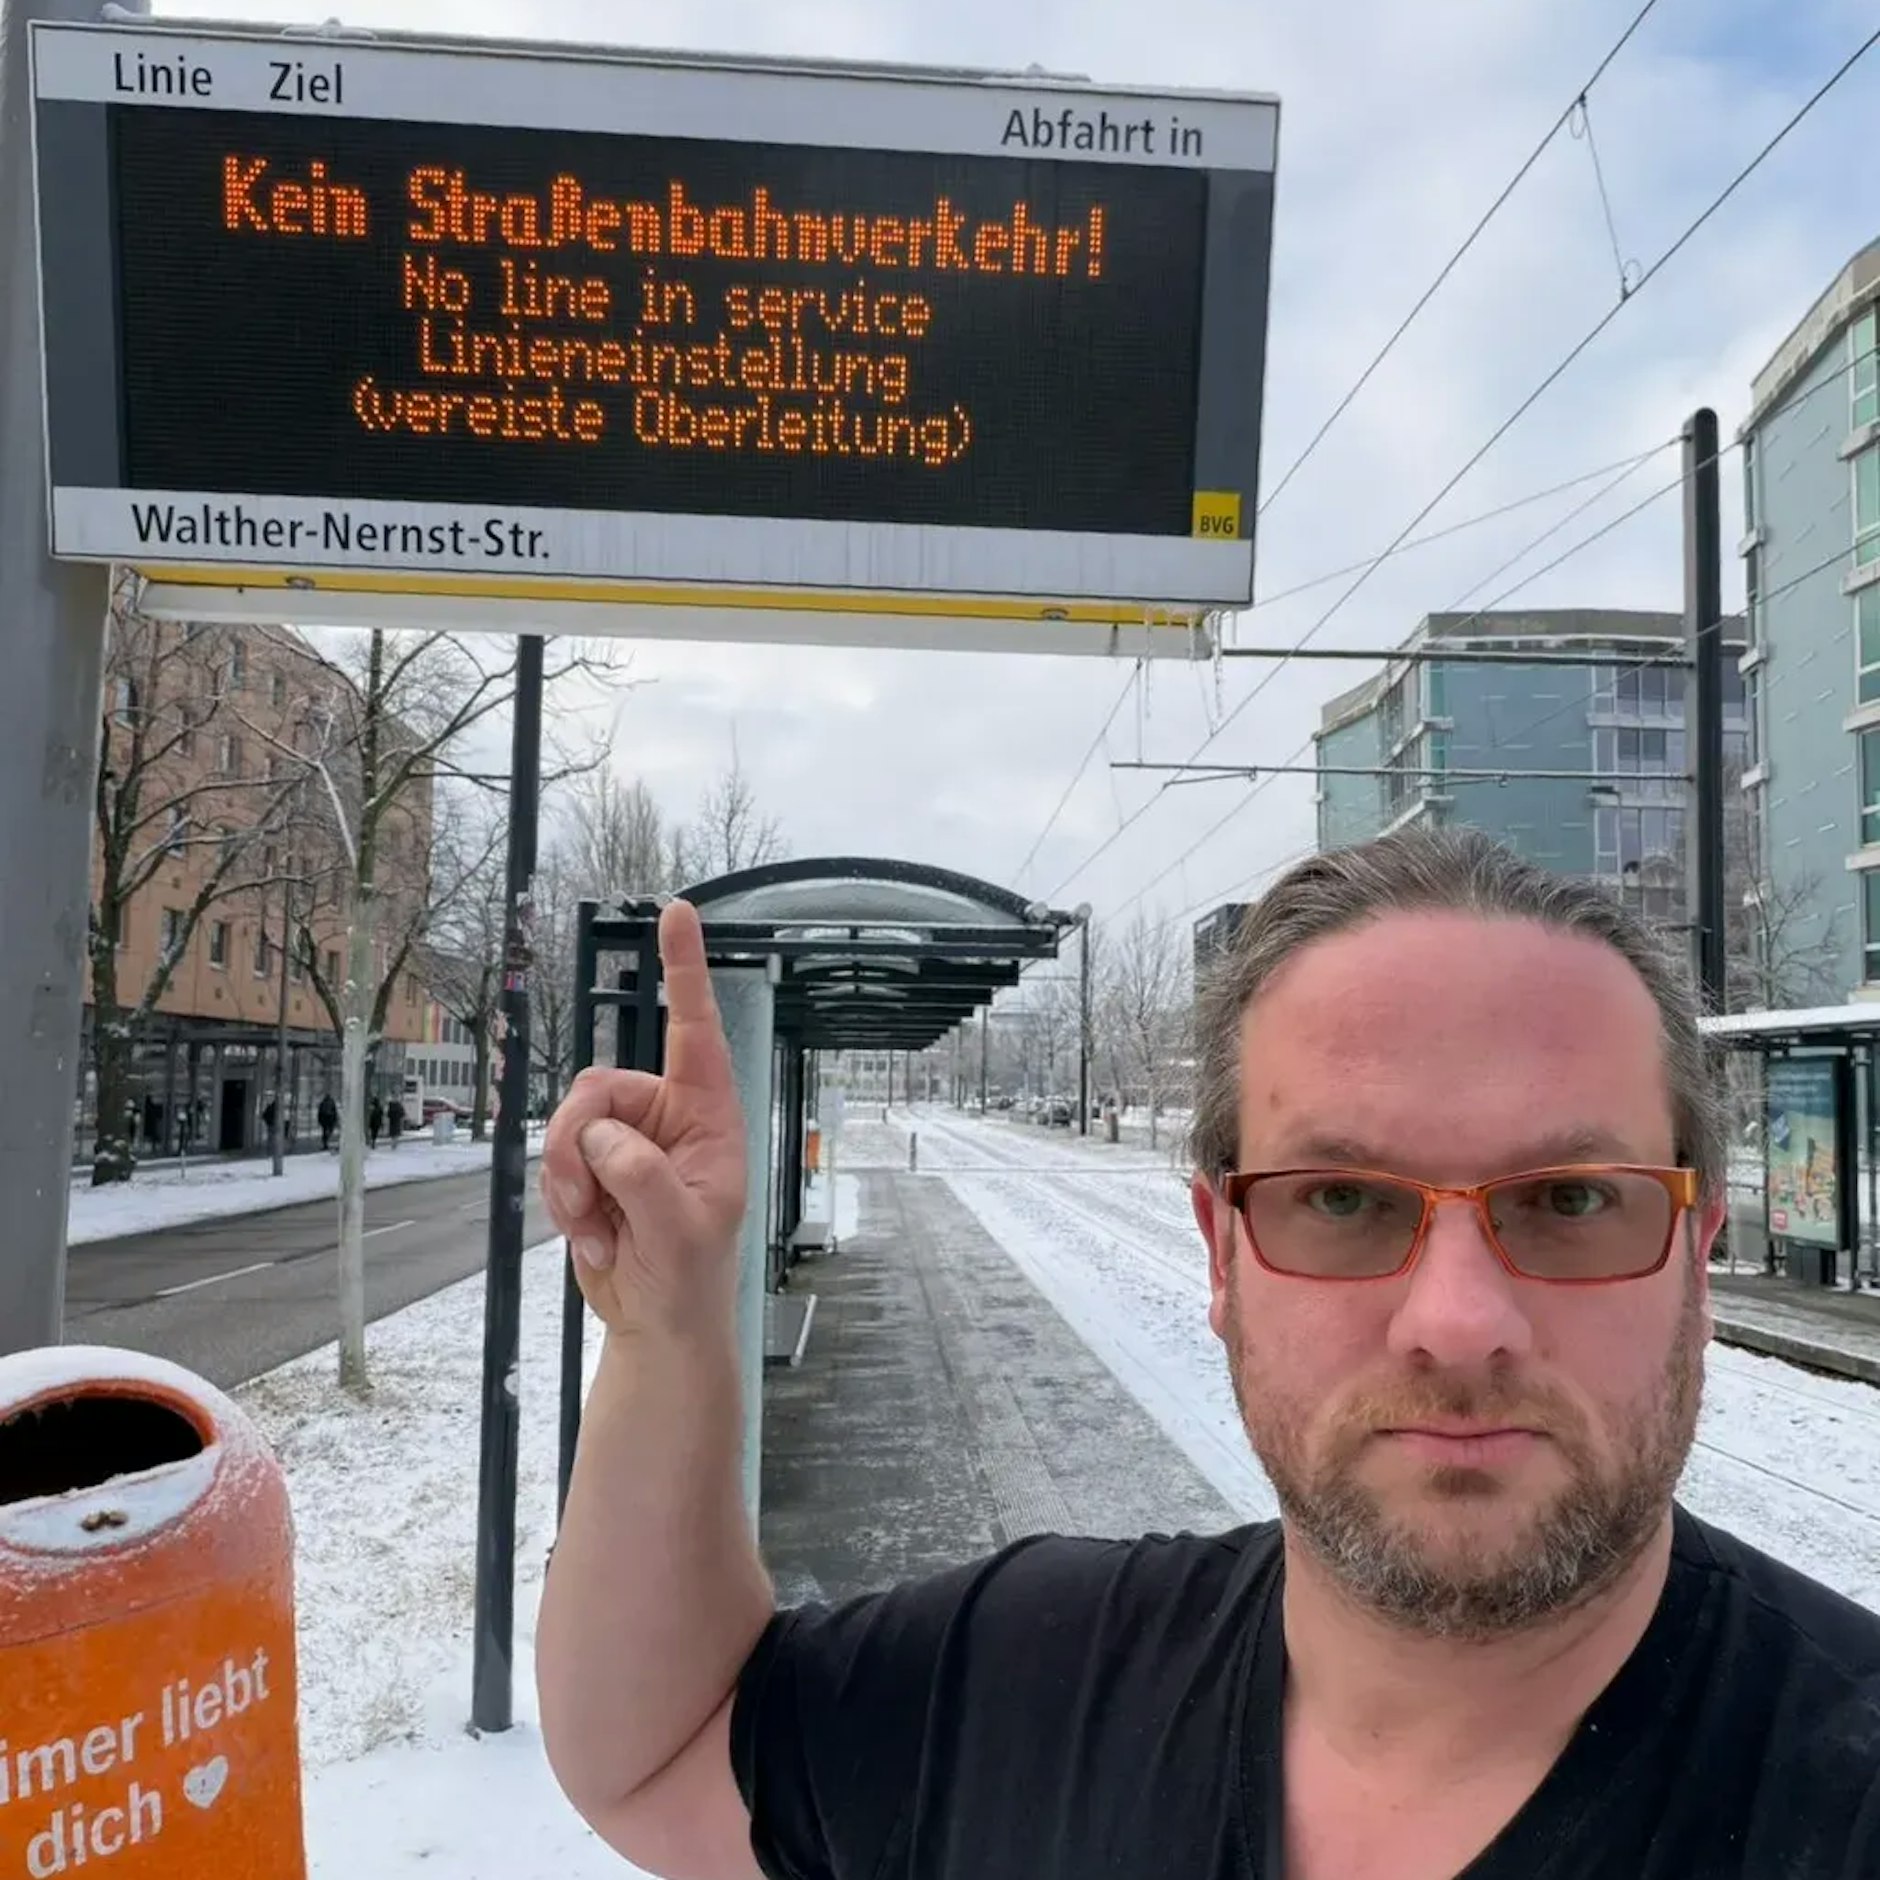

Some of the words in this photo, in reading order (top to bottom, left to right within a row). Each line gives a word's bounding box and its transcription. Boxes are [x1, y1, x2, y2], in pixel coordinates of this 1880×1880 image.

[113, 52, 213, 97] Linie
[269, 62, 344, 104] Ziel
[1001, 108, 1157, 155] Abfahrt
[1169, 117, 1203, 156] in
[223, 155, 367, 237] Kein
[408, 167, 1105, 278] Straßenbahnverkehr!
[403, 253, 471, 312] No
[500, 259, 611, 319] line
[641, 267, 694, 323] in
[725, 278, 932, 336] service
[420, 318, 909, 402] Linieneinstellung
[353, 375, 604, 442] (vereiste
[633, 388, 971, 465] Oberleitung)
[131, 503, 551, 558] Walther-Nernst-Str.
[1200, 515, 1235, 535] BVG
[163, 1647, 270, 1747] liebt
[27, 1782, 163, 1879] dich
